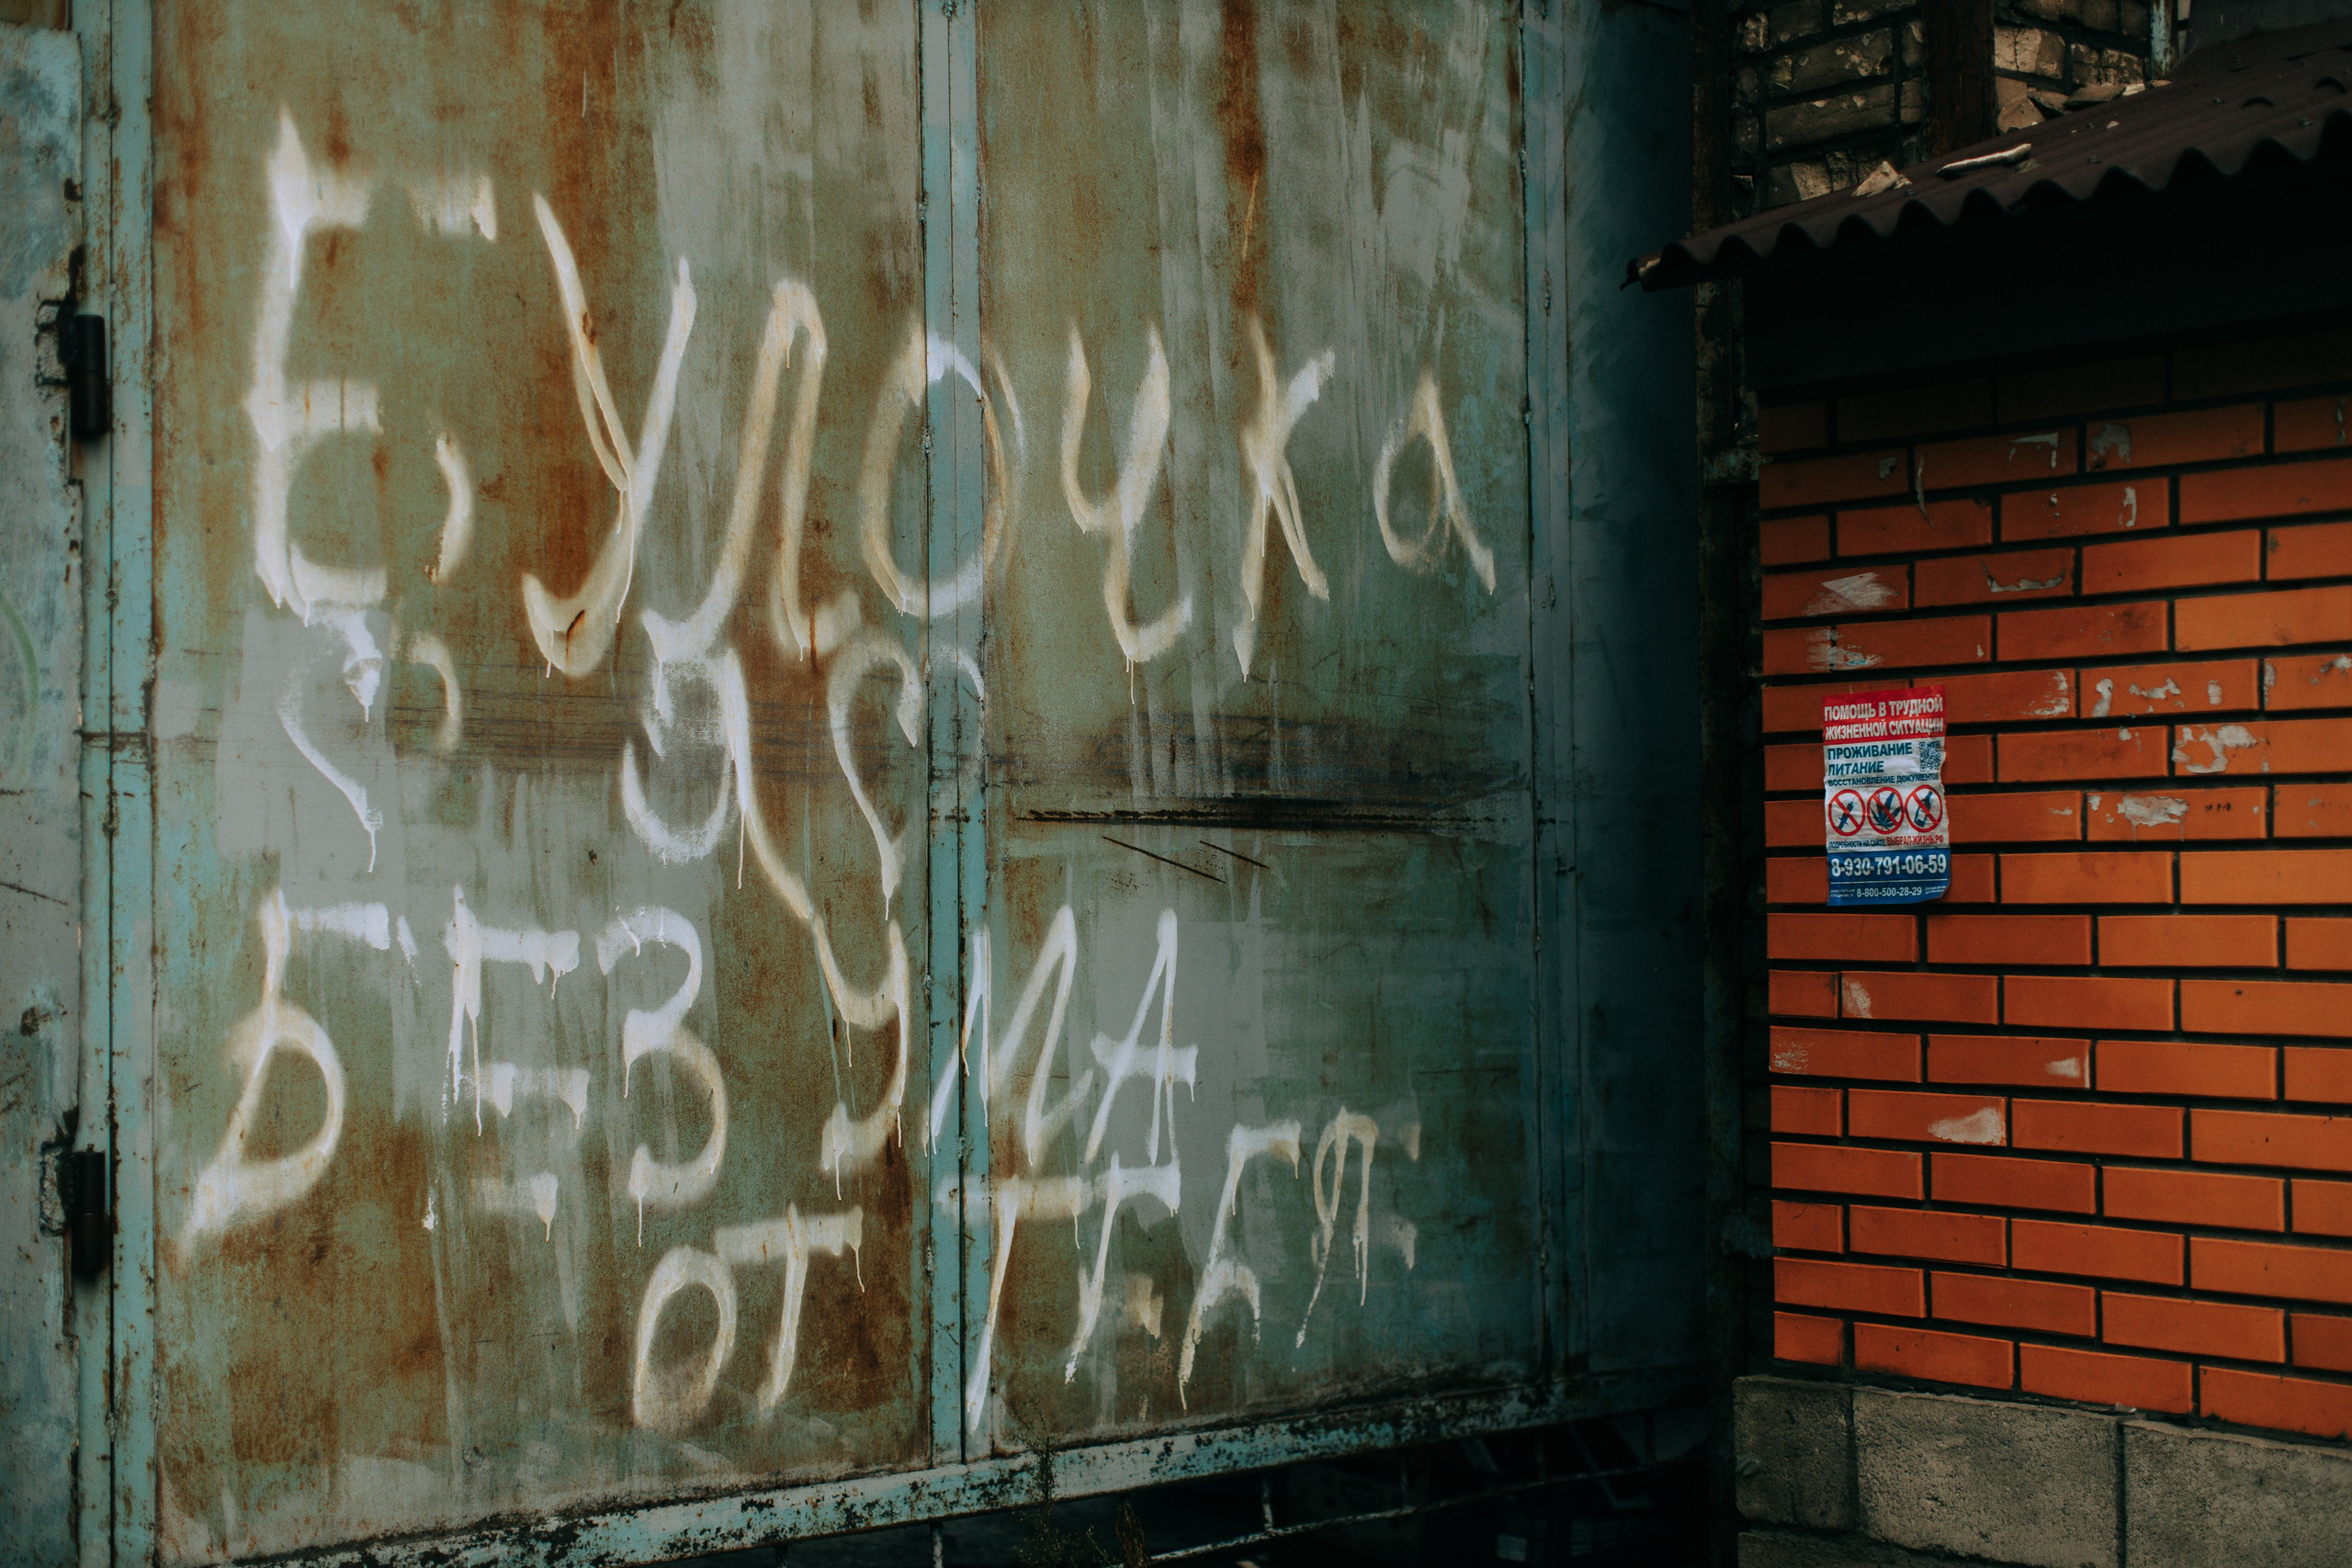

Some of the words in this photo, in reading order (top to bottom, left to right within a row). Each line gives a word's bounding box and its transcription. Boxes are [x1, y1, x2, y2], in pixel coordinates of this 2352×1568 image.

[1824, 703, 1876, 721] ПОМОЩЬ
[1878, 701, 1887, 717] В
[1889, 694, 1943, 716] ТРУДНОЙ
[1825, 718, 1887, 740] ЖИЗНЕННОЙ
[1888, 717, 1944, 736] СИТУАЦИИ
[1827, 742, 1913, 761] ПРОЖИВАНИЕ
[1827, 761, 1884, 776] ПИТАНИЕ
[1827, 775, 1894, 787] ВОССТАНОВЛЕНИЕ
[1896, 773, 1939, 784] ДОКУМЕНТОВ
[1886, 834, 1944, 845] ВЫБРАЛ-ЖИЗНЬ.РФ
[1830, 853, 1947, 877] 8-930-791-06-59
[1857, 886, 1922, 897] 8-800-500-28-29
